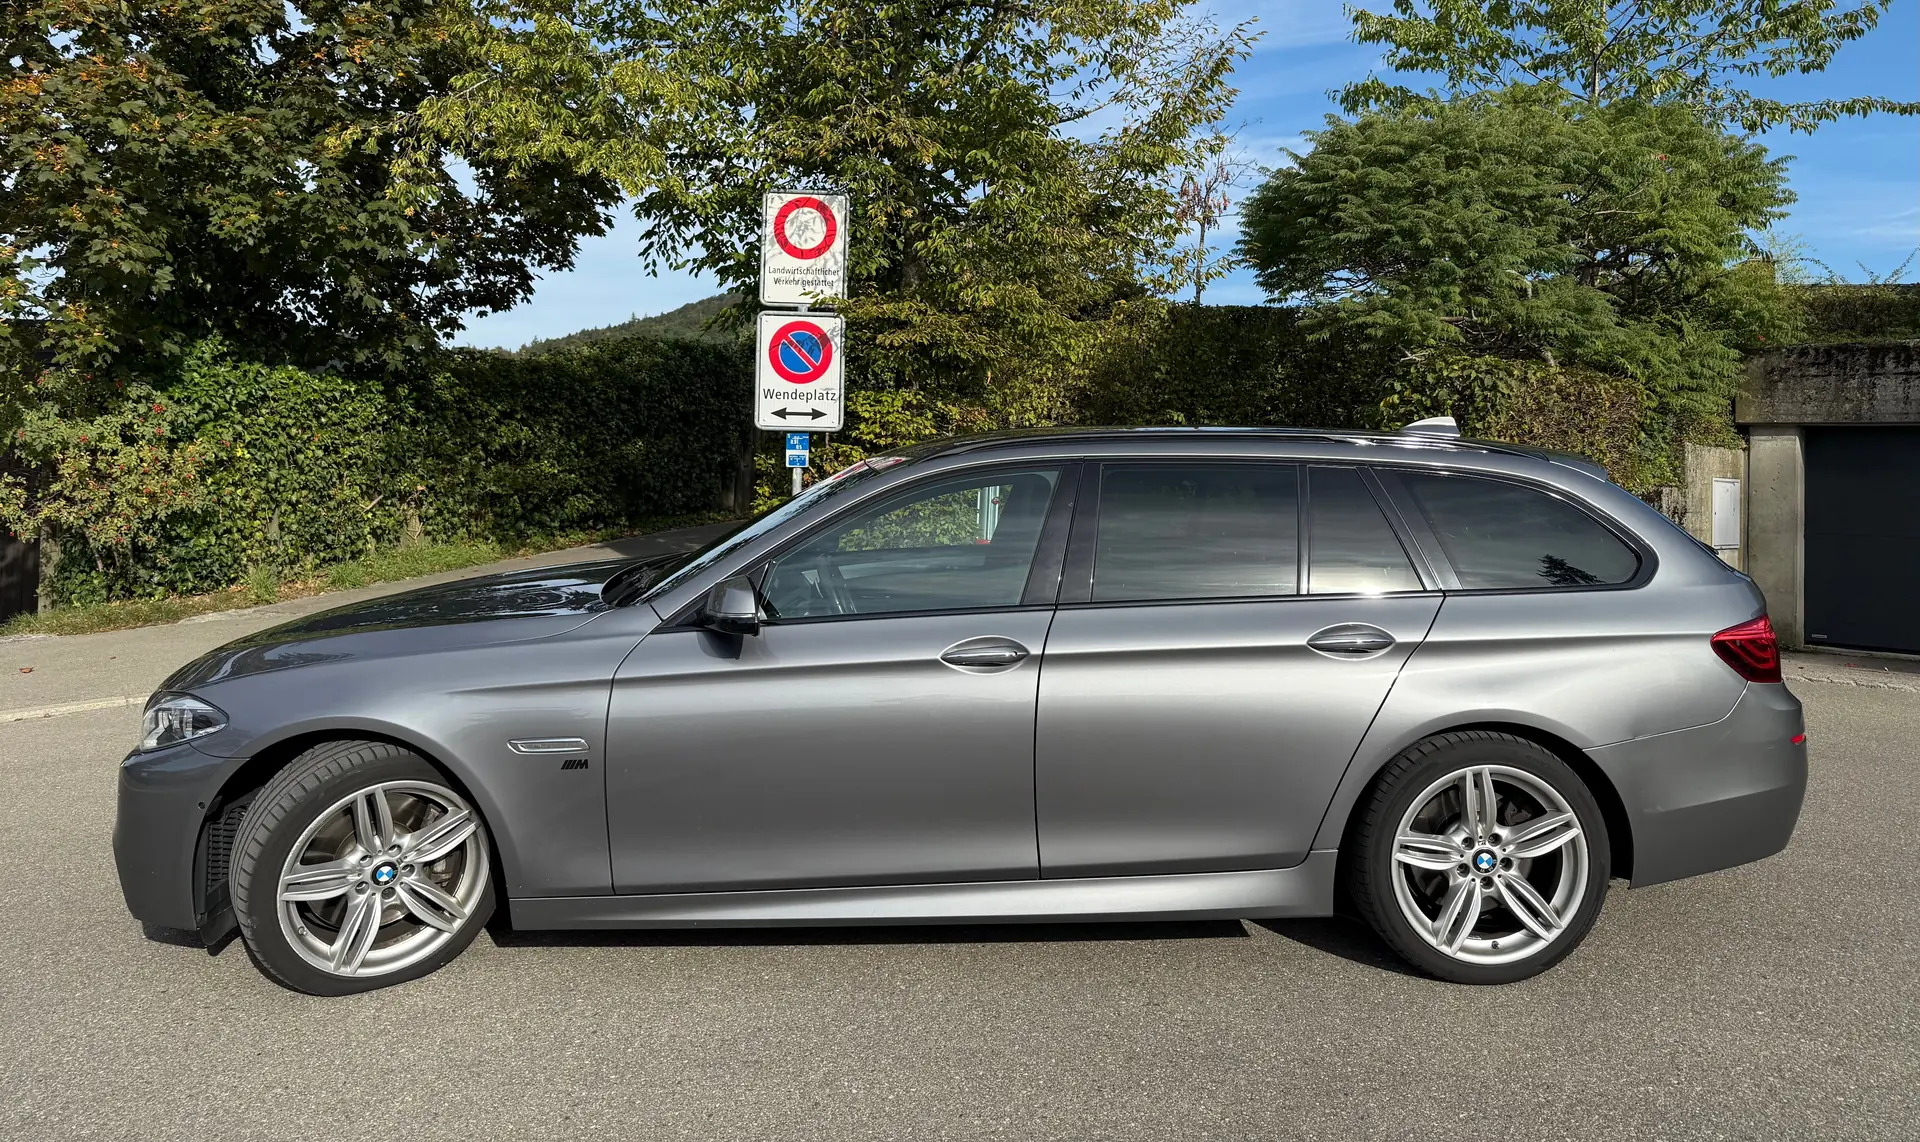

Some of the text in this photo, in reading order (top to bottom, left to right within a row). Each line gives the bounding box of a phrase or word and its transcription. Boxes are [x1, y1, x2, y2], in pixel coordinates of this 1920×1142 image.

[768, 266, 840, 276] Landwirtschaftlicher
[773, 277, 834, 288] Verkehr gestattet
[763, 388, 836, 403] Wendeplatz
